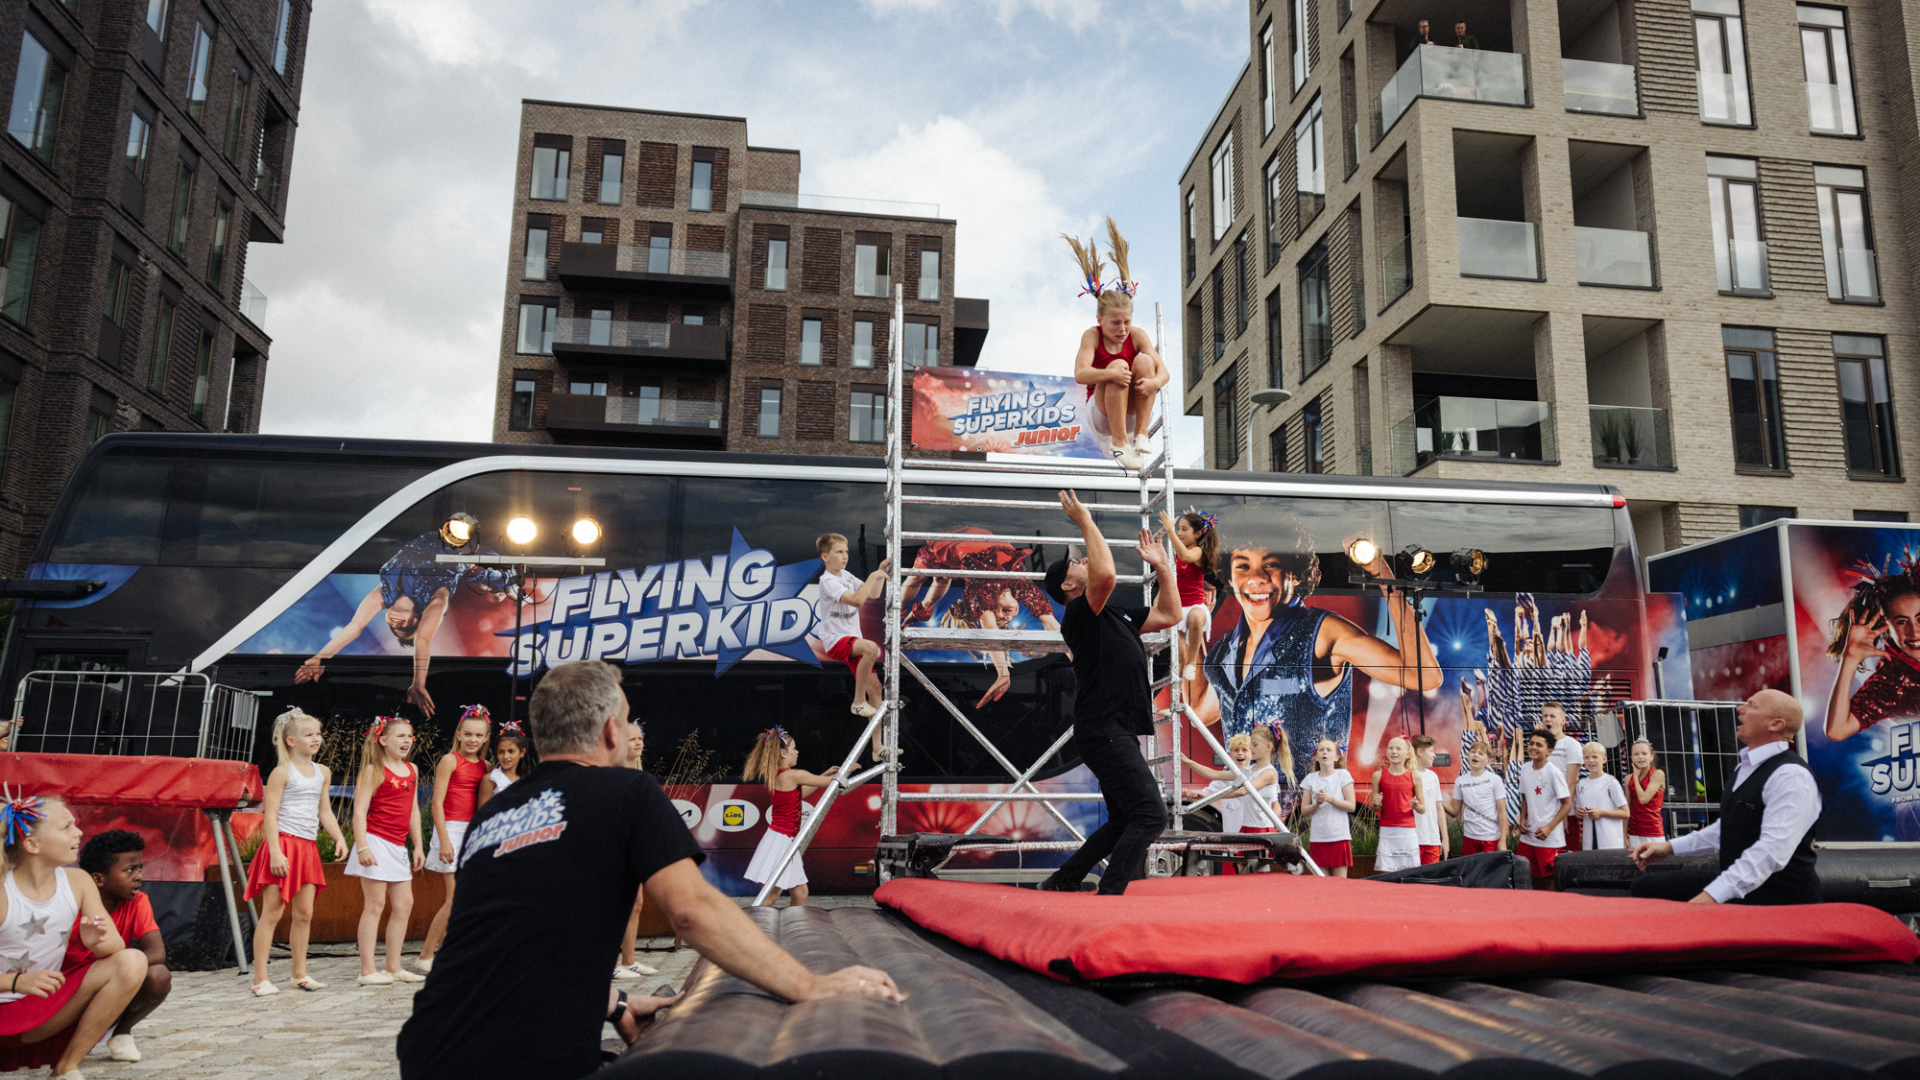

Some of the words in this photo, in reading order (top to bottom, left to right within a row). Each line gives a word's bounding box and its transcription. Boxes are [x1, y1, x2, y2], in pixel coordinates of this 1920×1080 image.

[952, 404, 1076, 435] SUPERKIDS
[967, 388, 1047, 416] FLYING
[551, 548, 776, 625] FLYING
[505, 597, 821, 679] SUPERKID
[1891, 793, 1913, 804] FROM
[465, 802, 530, 849] FLYING
